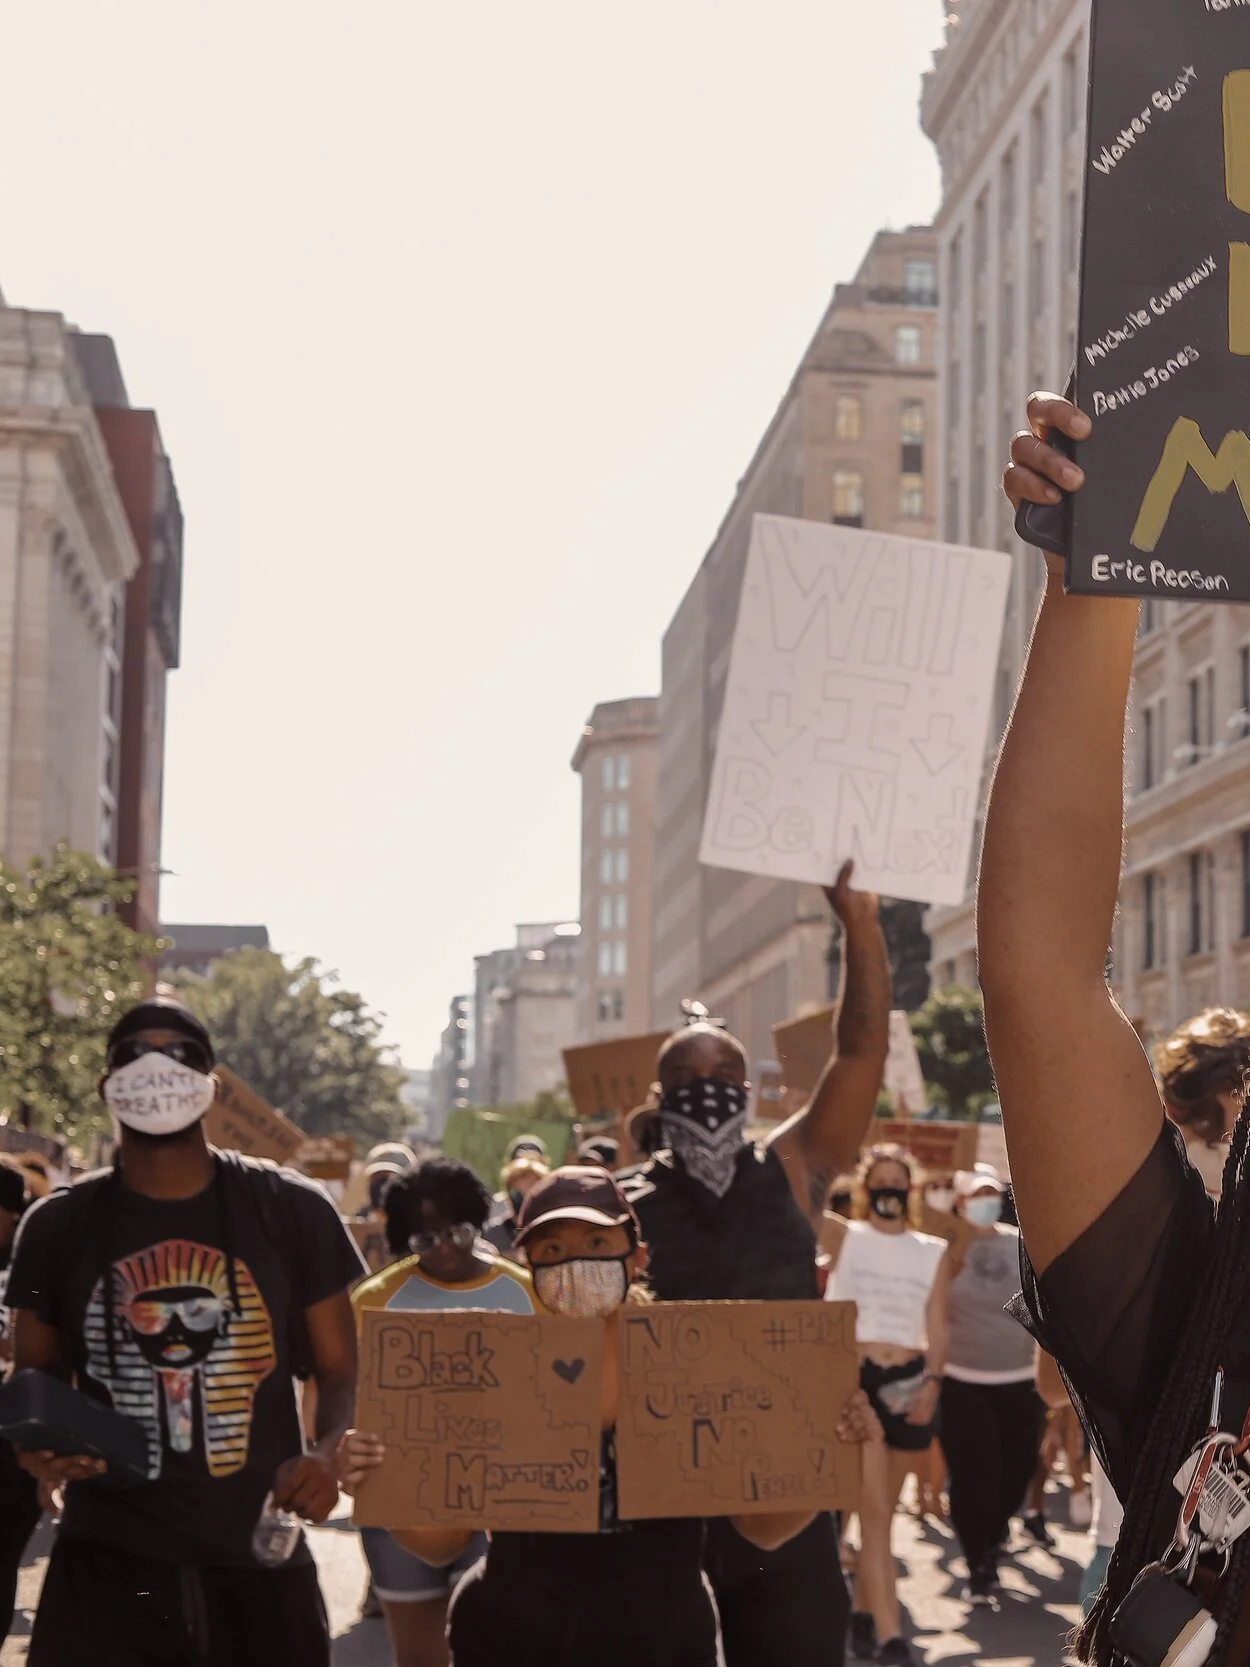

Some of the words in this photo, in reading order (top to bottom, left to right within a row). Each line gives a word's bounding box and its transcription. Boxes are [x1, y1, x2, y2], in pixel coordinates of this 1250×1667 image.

[1092, 106, 1151, 174] Walter
[1085, 309, 1151, 367] Michelle
[1143, 345, 1200, 388] Jones
[758, 521, 974, 677] Will
[1091, 553, 1148, 583] Eric
[1149, 559, 1230, 591] Reason
[814, 670, 911, 776] I
[378, 1326, 500, 1390] Black
[624, 1311, 712, 1373] NO
[404, 1394, 504, 1445] Lives
